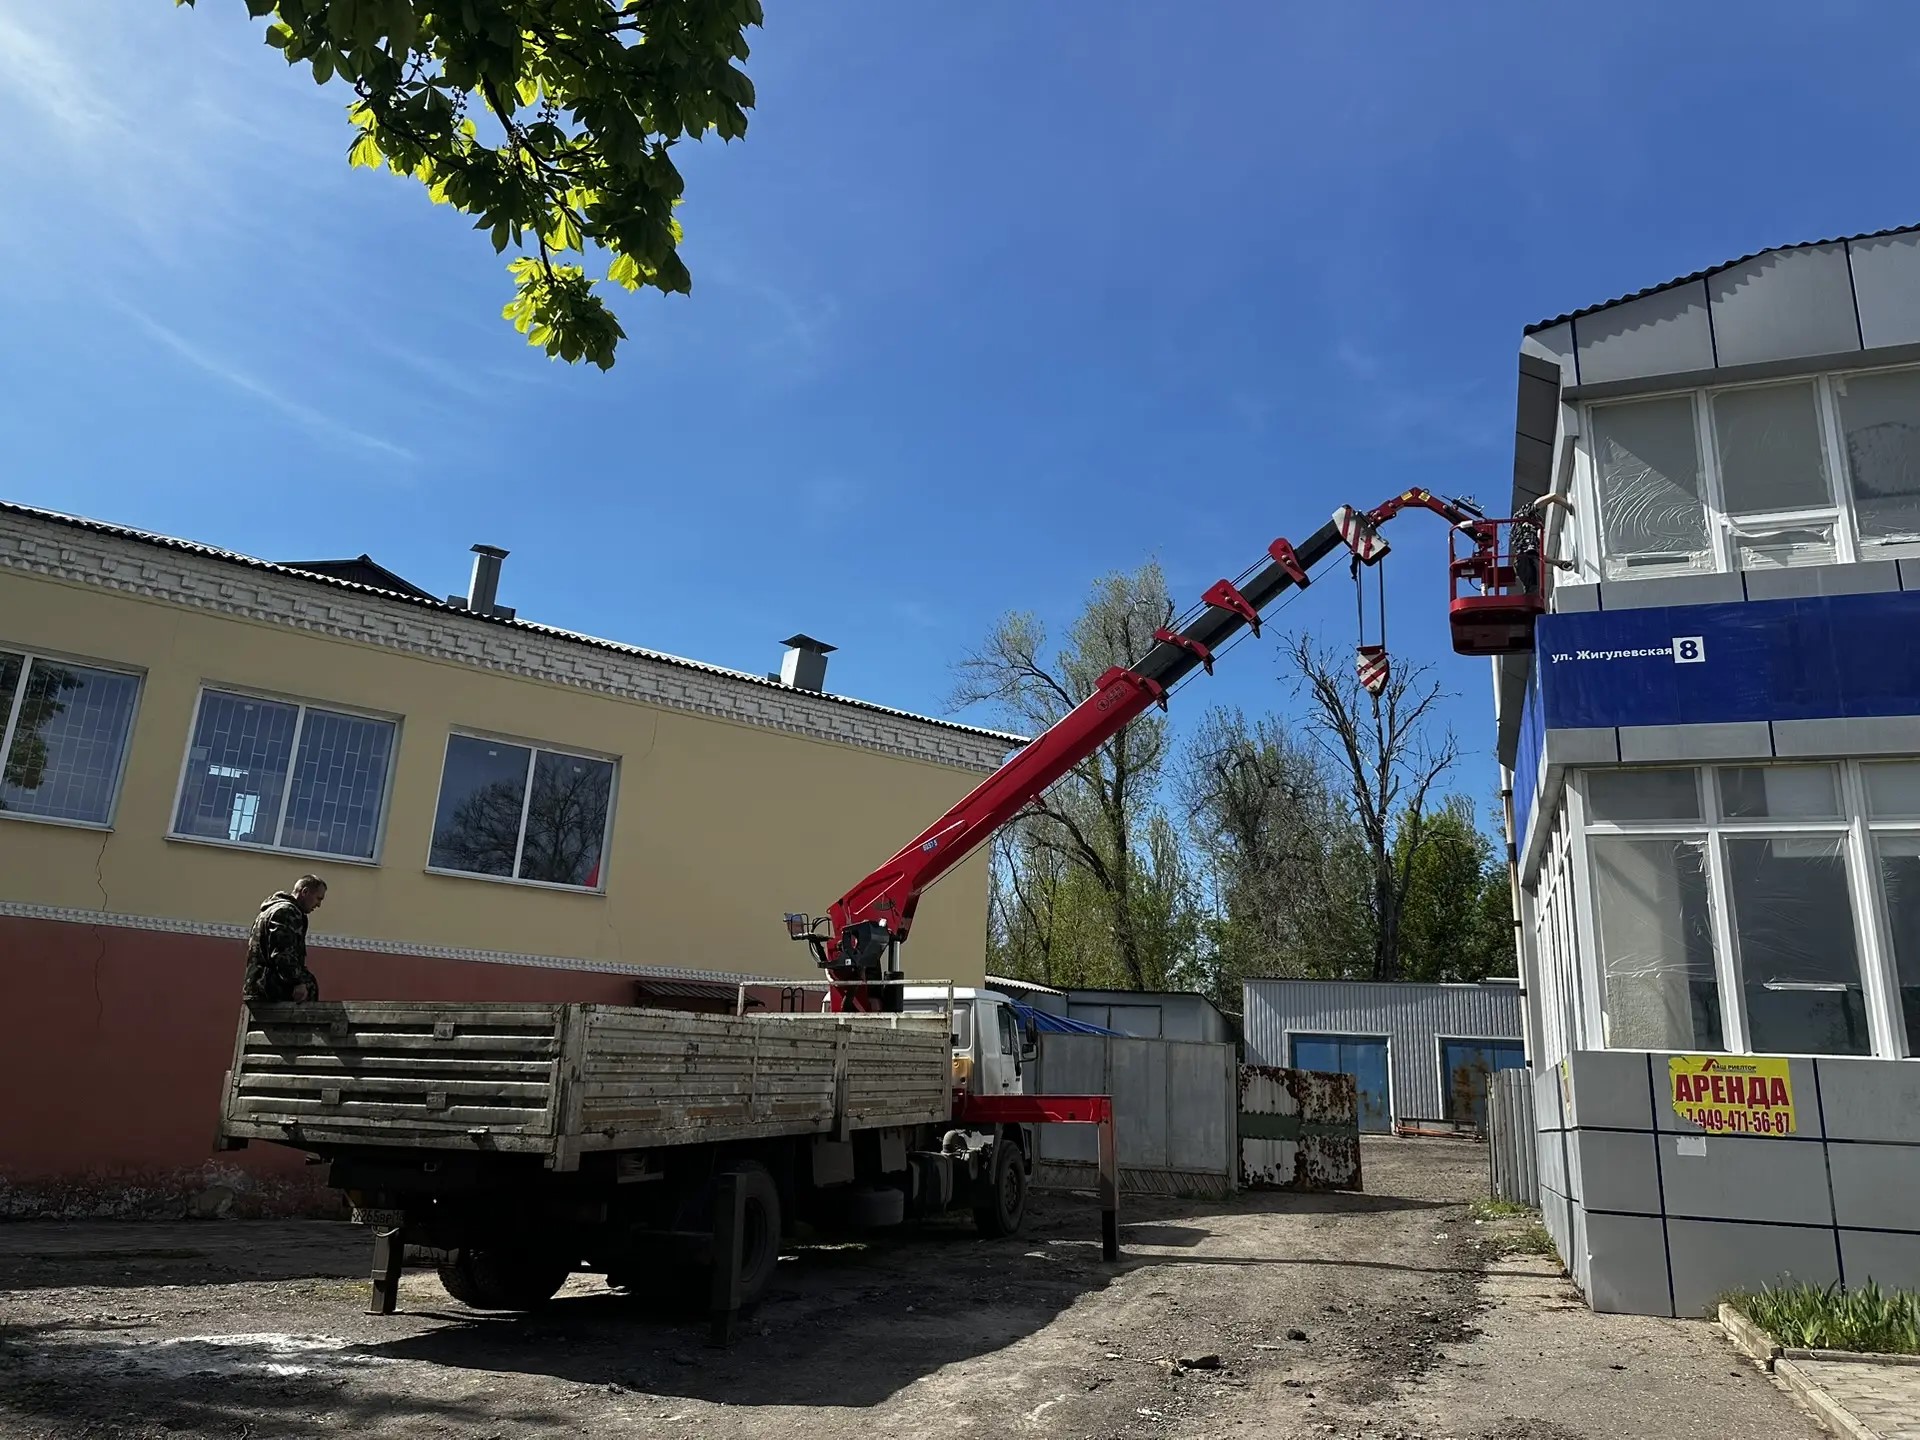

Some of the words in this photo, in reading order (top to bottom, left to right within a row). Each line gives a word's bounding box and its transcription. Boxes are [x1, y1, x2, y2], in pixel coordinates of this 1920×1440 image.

[1552, 652, 1573, 663] ул.
[1576, 648, 1672, 661] Жигулевская
[1679, 640, 1699, 660] 8
[1675, 1074, 1790, 1110] АРЕНДА
